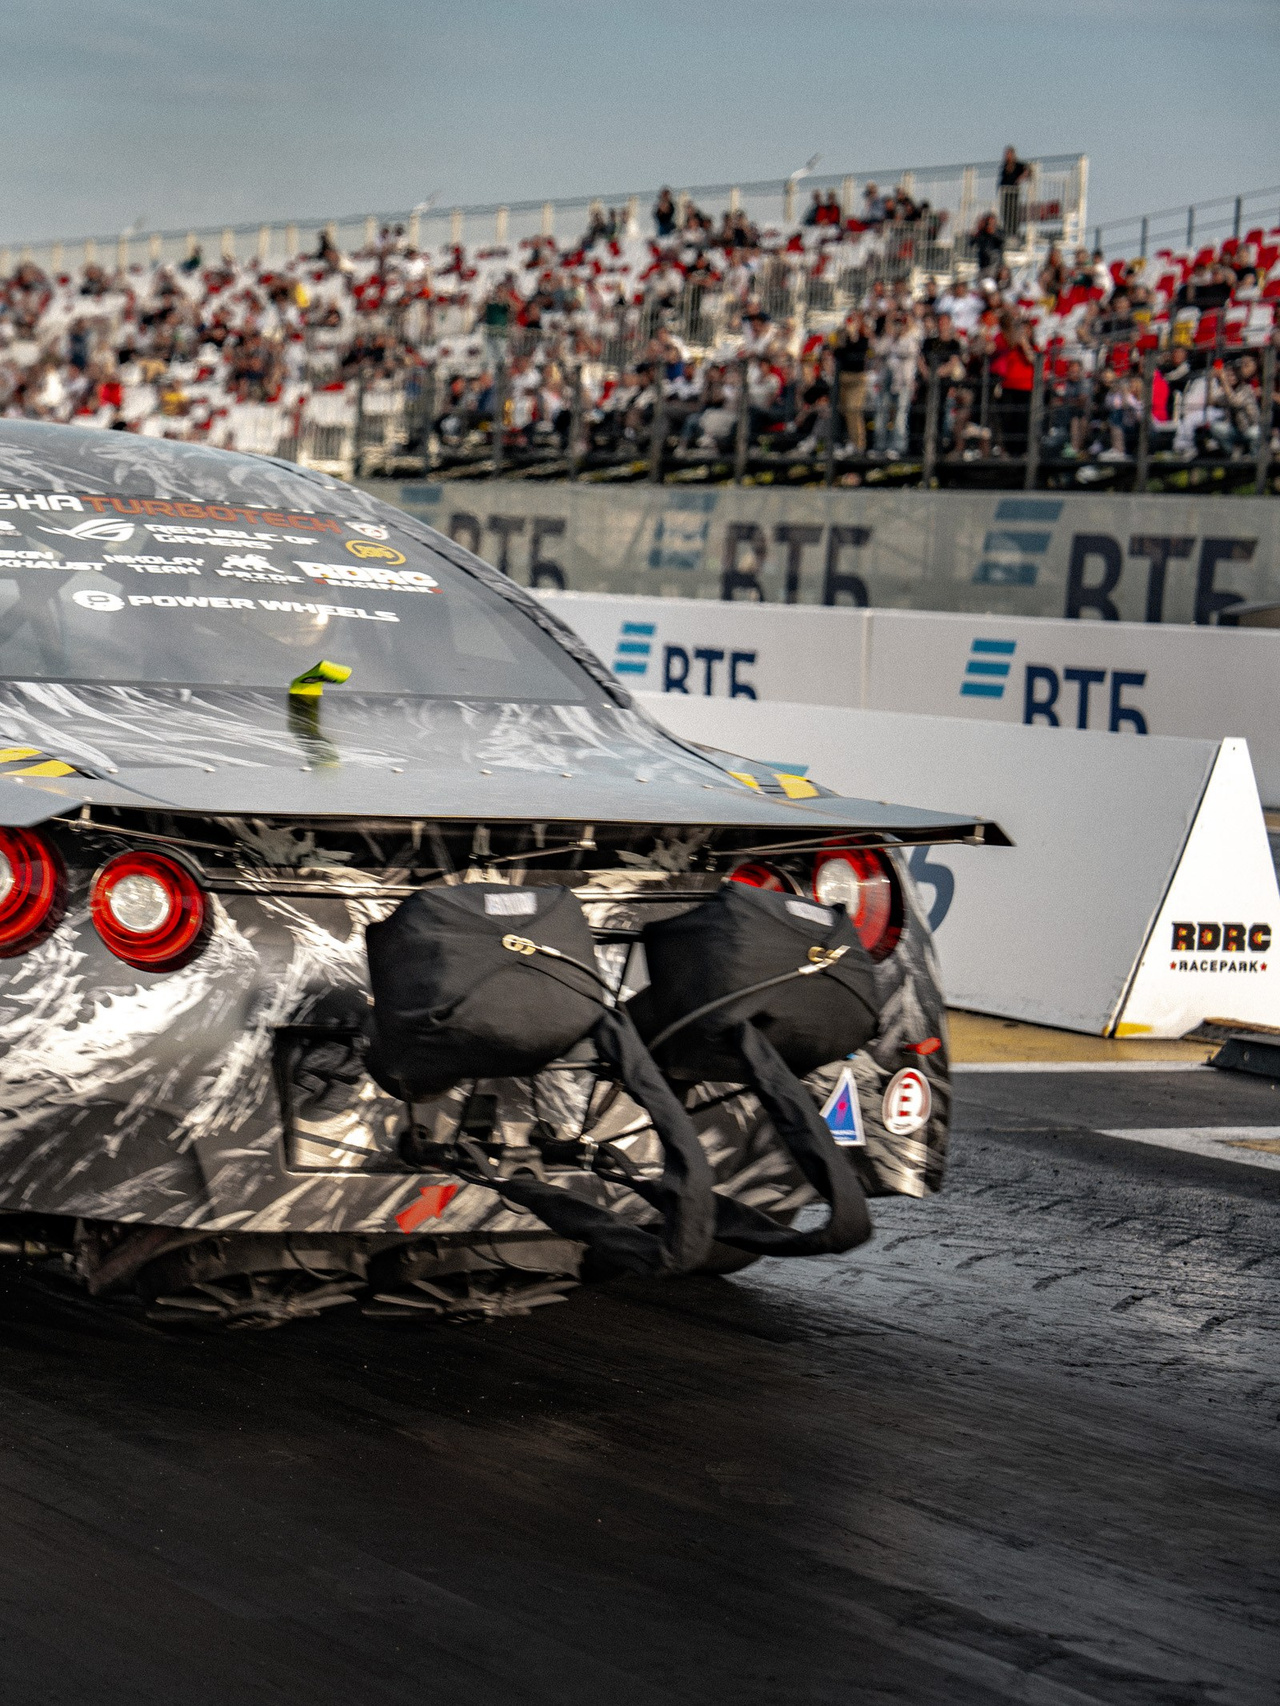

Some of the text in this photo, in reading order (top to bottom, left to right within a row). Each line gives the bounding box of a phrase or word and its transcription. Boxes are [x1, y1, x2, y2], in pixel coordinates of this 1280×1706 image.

[144, 524, 320, 545] REPUBLIC OF
[153, 533, 274, 551] GAMERS
[102, 554, 205, 567] NIKOLAY
[126, 564, 202, 576] TEAM
[214, 569, 307, 584] PRIDE
[292, 560, 439, 587] RDRC
[127, 595, 400, 622] POWER WHEELS
[1171, 921, 1272, 953] RDRC
[1179, 960, 1258, 973] RACEPARK
